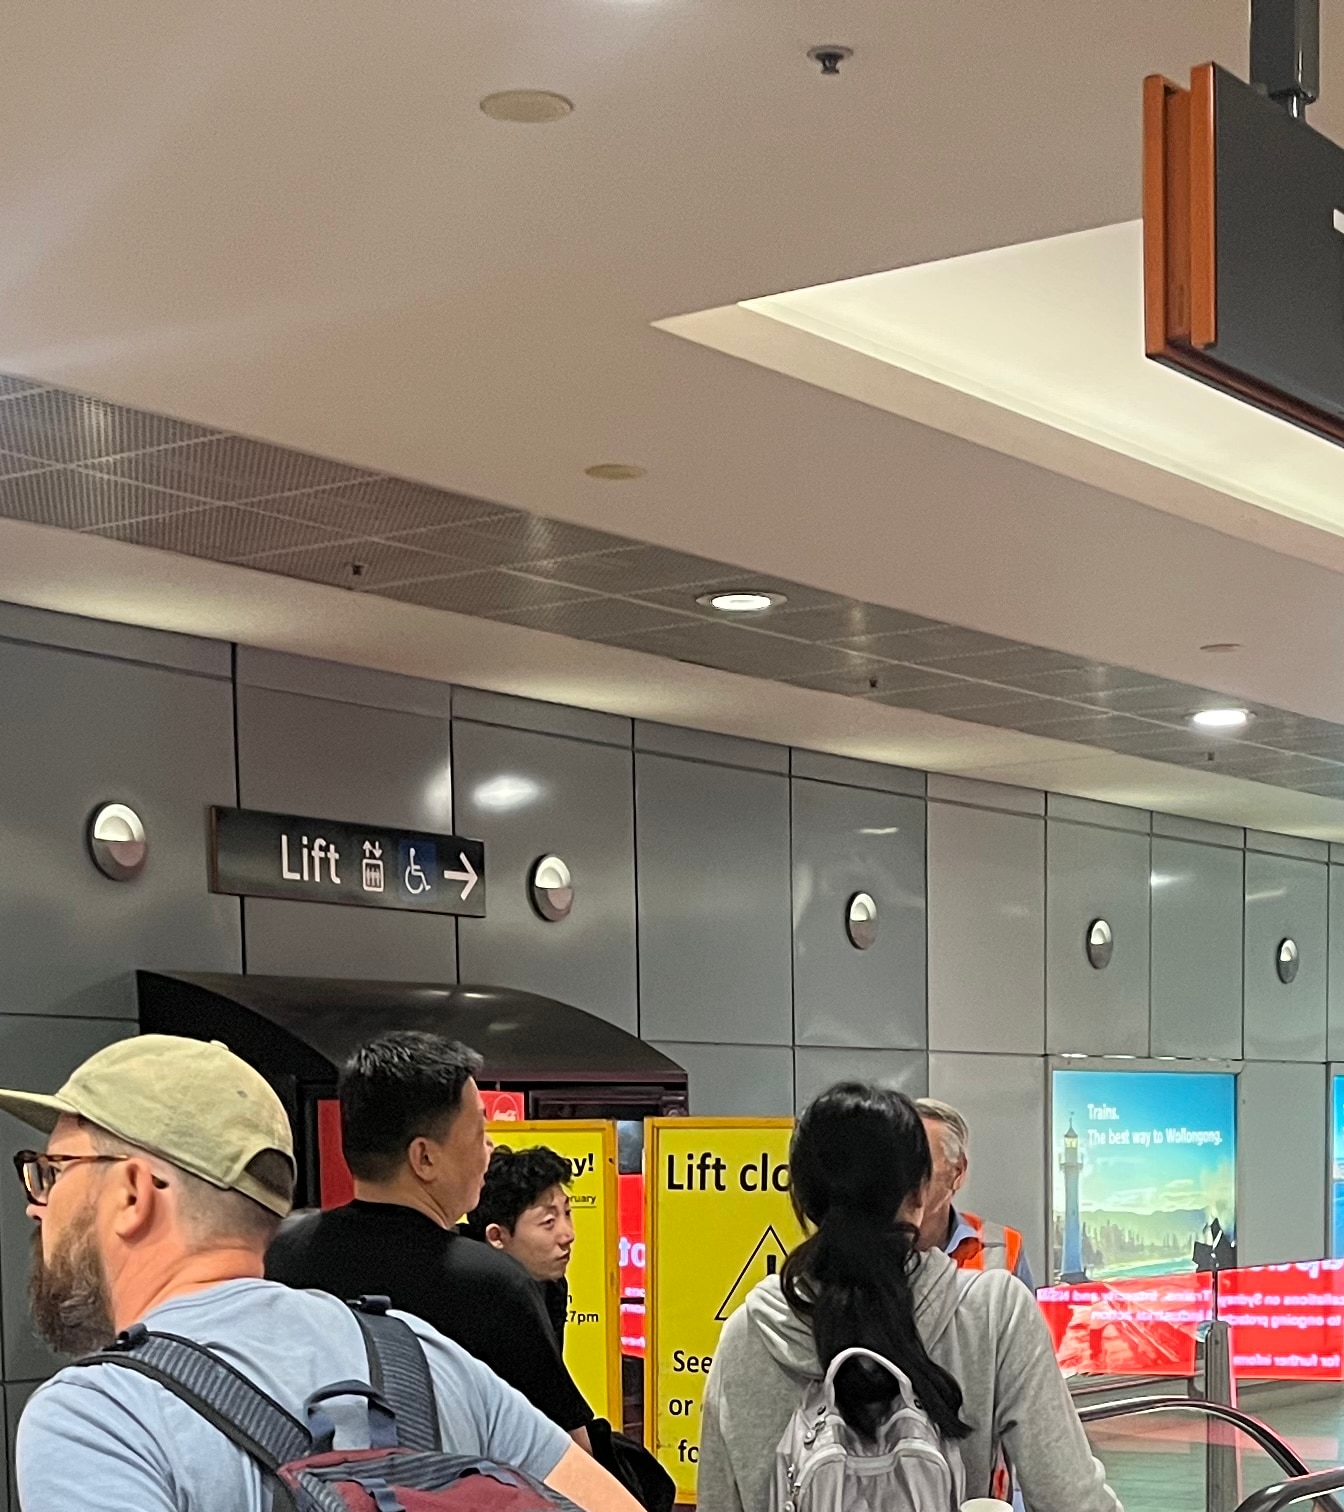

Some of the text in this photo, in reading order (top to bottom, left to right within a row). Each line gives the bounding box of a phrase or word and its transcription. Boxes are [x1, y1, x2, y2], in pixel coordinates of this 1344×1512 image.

[281, 834, 341, 884] Lift
[1087, 1104, 1119, 1120] Trains.
[1088, 1129, 1106, 1145] The
[1109, 1129, 1130, 1145] best
[1132, 1131, 1151, 1147] way
[1153, 1129, 1163, 1144] to
[667, 1152, 791, 1192] Lift clo
[673, 1350, 712, 1374] See
[669, 1399, 693, 1416] or
[678, 1439, 699, 1463] fo
